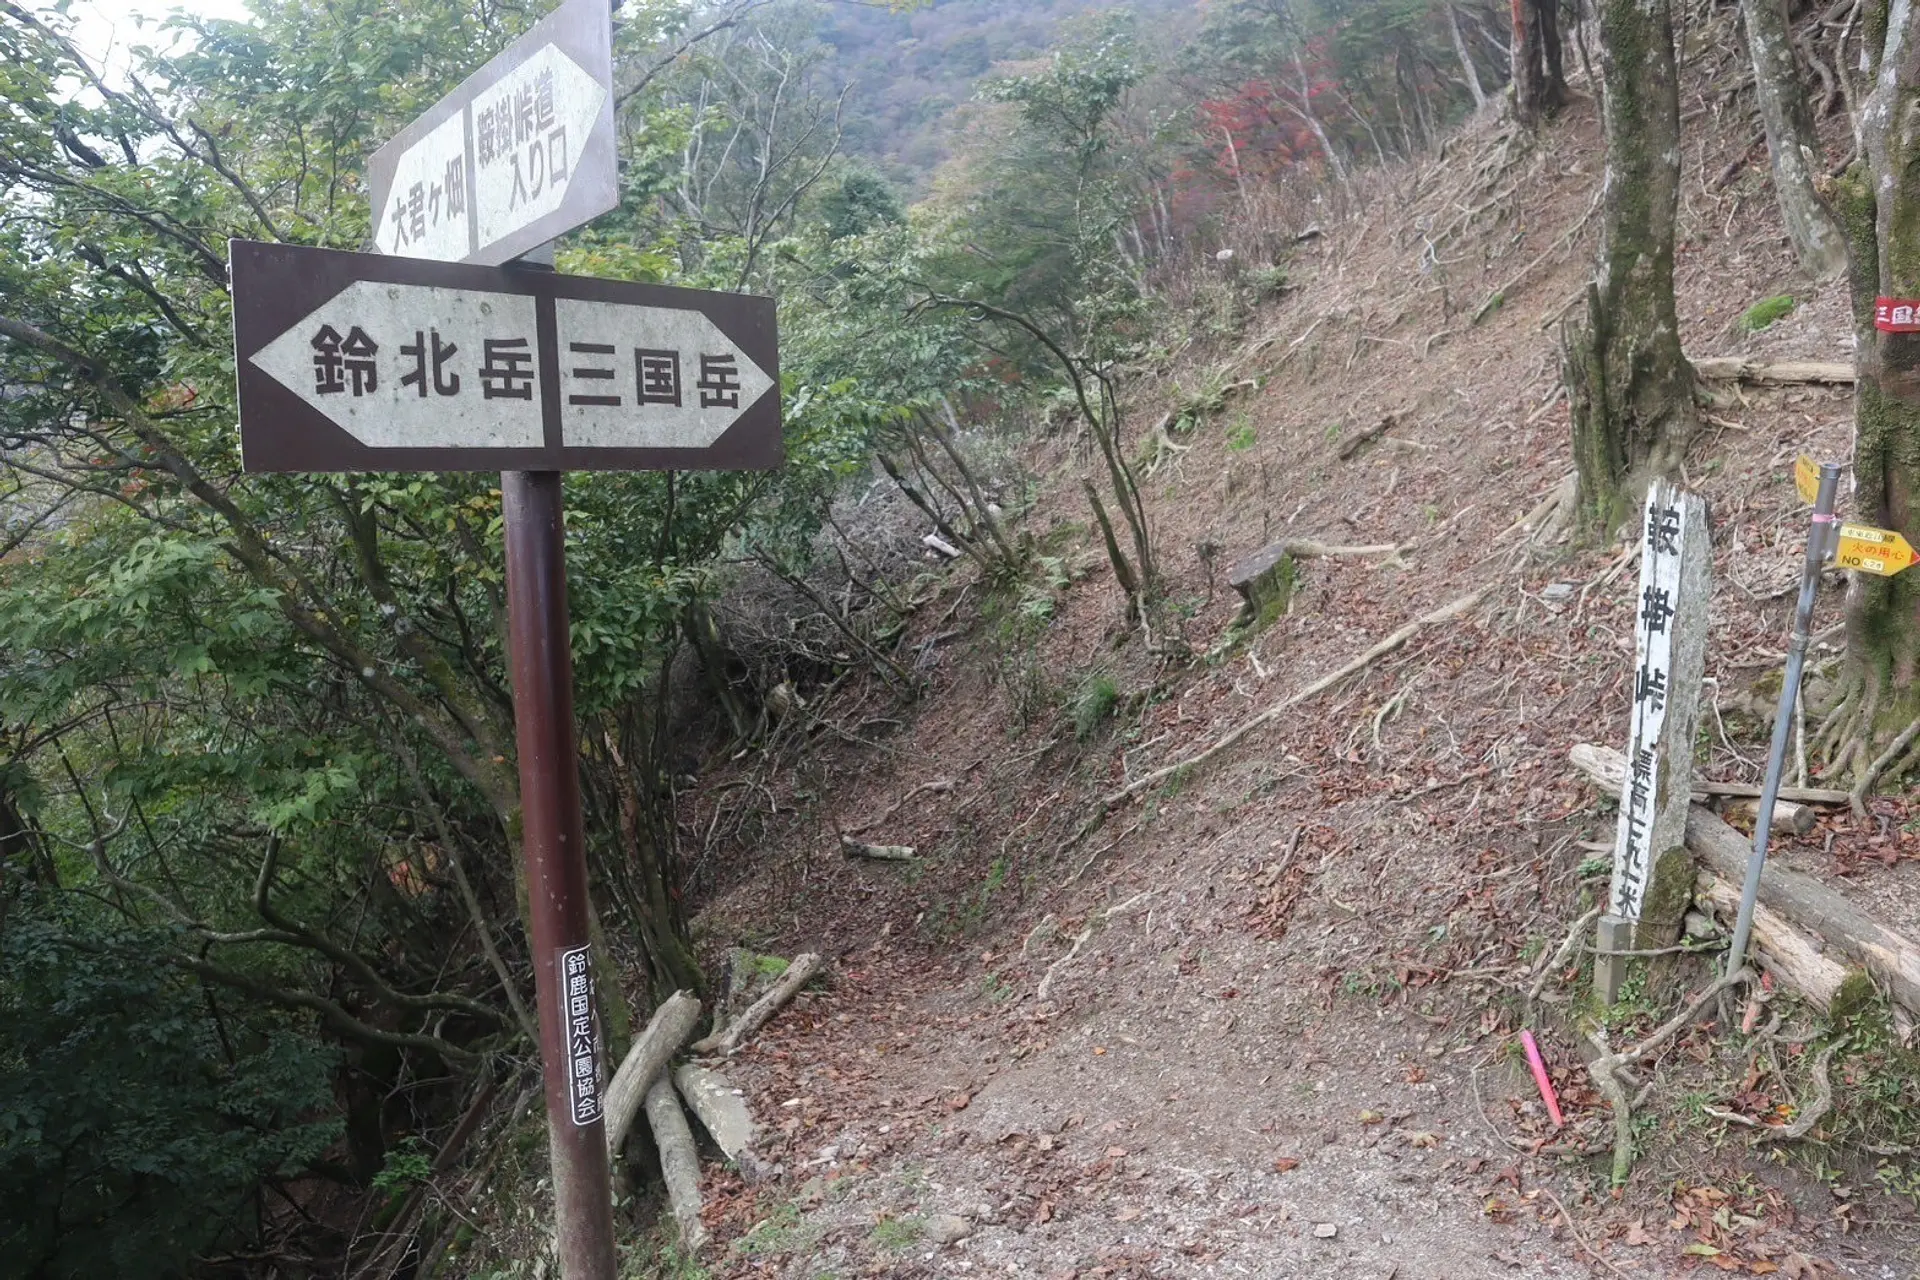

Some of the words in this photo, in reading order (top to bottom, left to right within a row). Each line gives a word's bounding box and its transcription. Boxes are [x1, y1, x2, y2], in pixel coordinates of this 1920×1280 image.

[507, 124, 568, 213] 入り口
[310, 323, 535, 401] 鈴北岳
[568, 341, 741, 410] 三国岳
[1841, 554, 1861, 567] NO
[1852, 542, 1905, 561] 火の用心
[567, 953, 597, 1119] 鈴鹿国定公園協会
